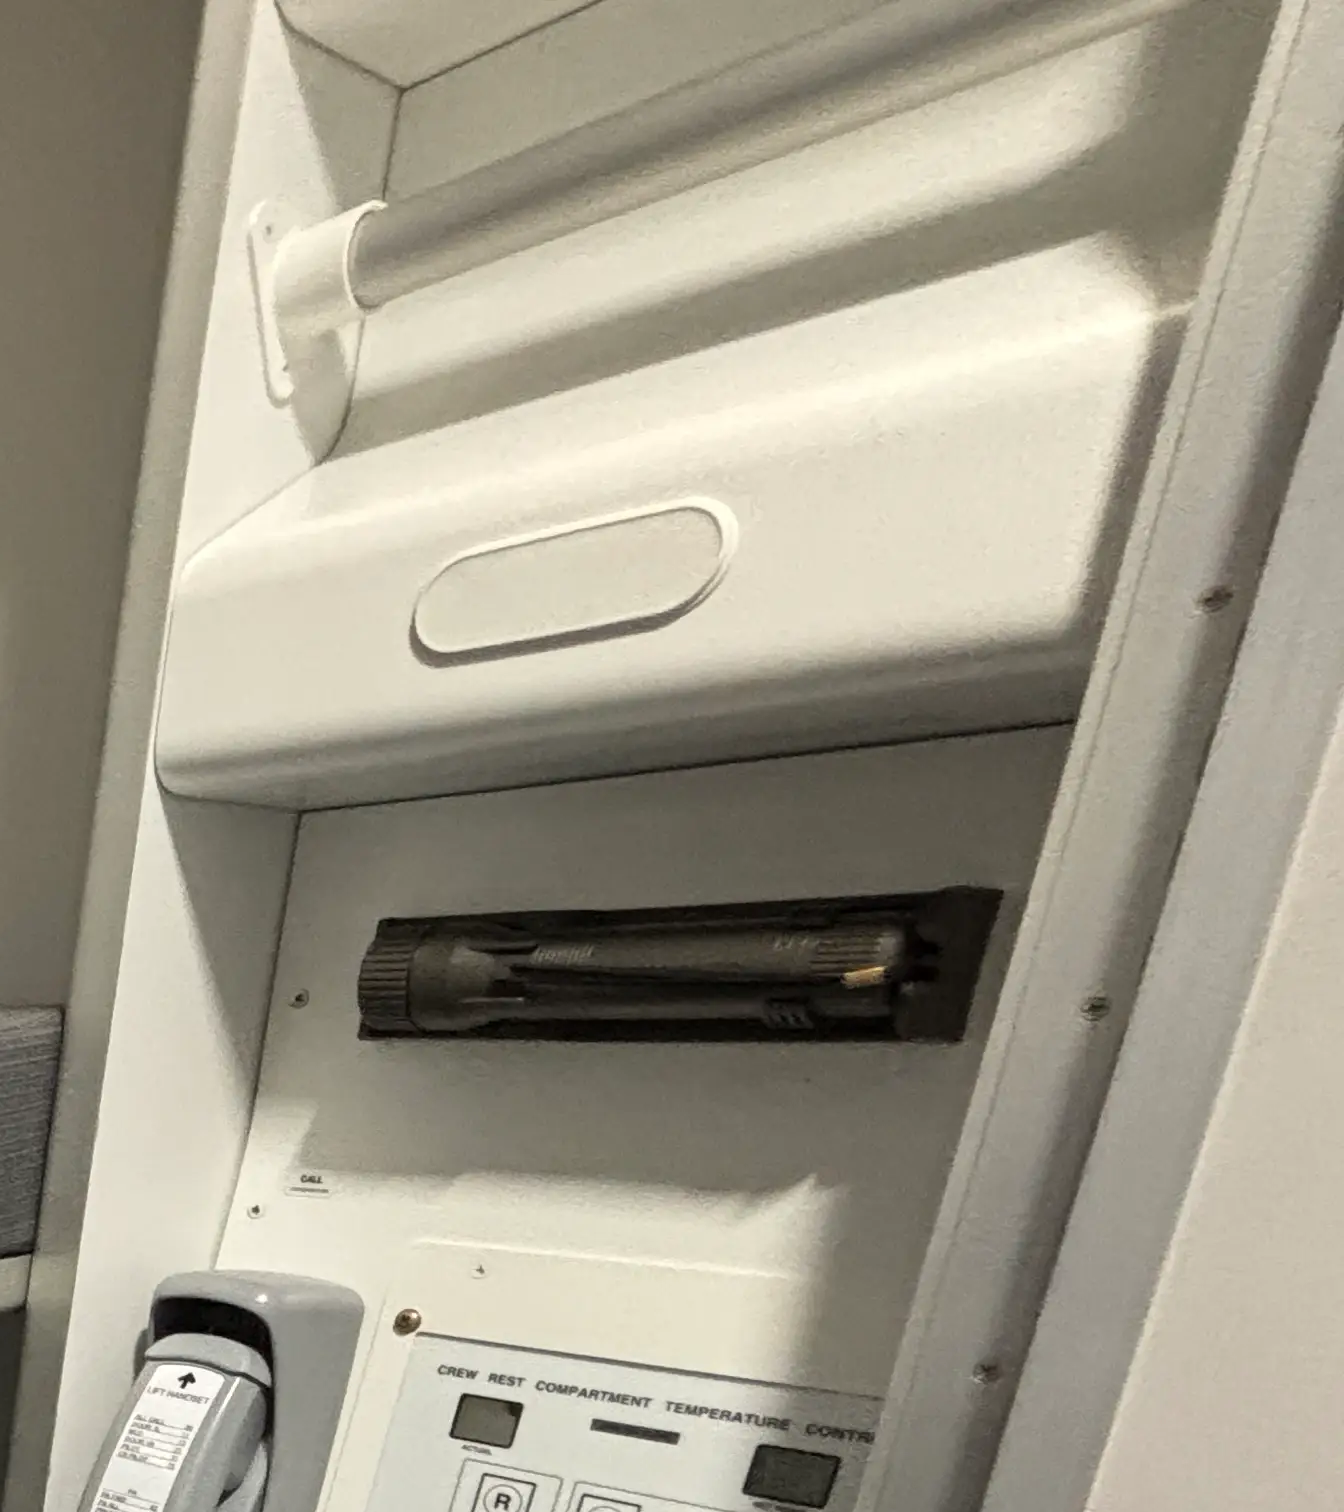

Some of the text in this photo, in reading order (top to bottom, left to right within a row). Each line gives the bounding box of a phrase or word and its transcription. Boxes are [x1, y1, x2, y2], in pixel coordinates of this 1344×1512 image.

[436, 1364, 479, 1380] CREW
[487, 1372, 526, 1388] REST
[535, 1380, 653, 1409] COMPARTMENT
[665, 1400, 792, 1431] TEMPERATURE
[493, 1492, 512, 1511] R
